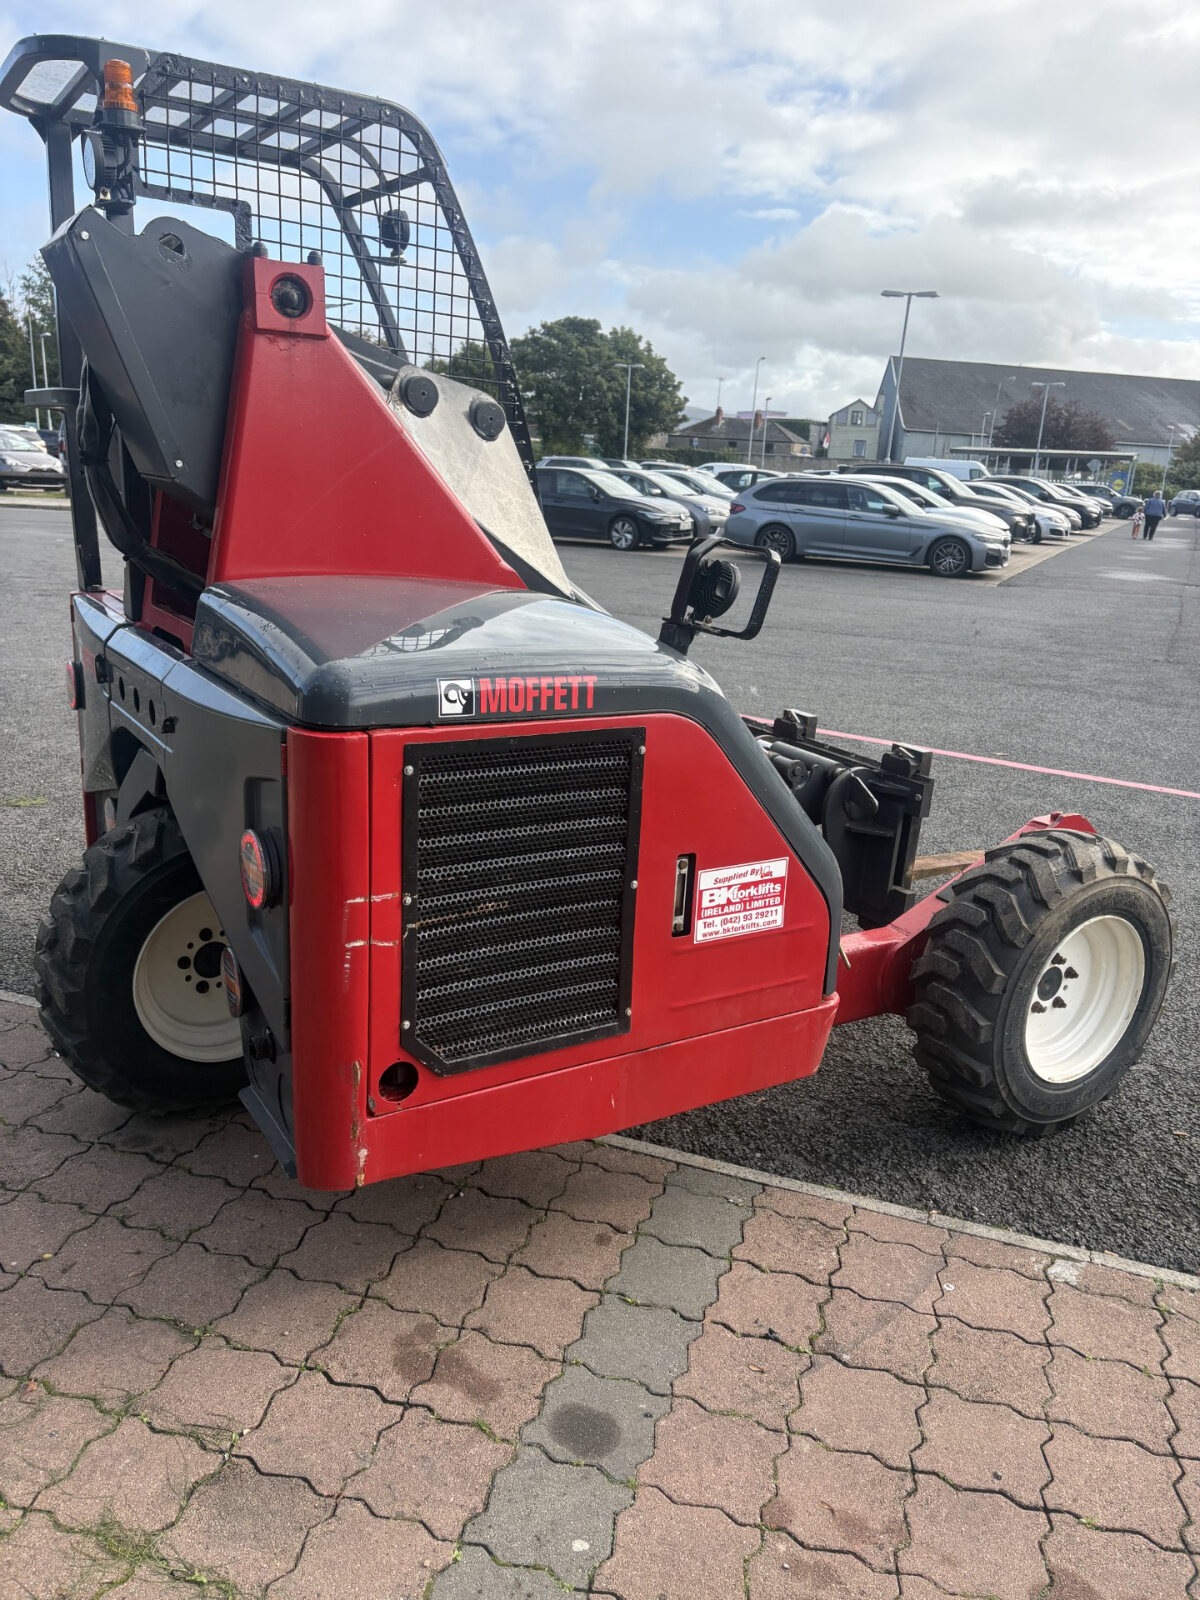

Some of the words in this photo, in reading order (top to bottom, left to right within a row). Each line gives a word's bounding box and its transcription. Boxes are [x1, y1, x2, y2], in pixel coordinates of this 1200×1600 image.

[479, 675, 598, 714] MOFFETT
[713, 870, 748, 885] Supplied
[750, 868, 760, 878] By
[701, 903, 744, 918] (IRELAND)
[746, 896, 781, 910] LIMITED
[702, 920, 718, 929] Tel.
[720, 915, 741, 926] (042)
[743, 913, 753, 922] 93
[755, 908, 778, 919] 29211
[702, 919, 778, 938] www.bkforklifts.com
